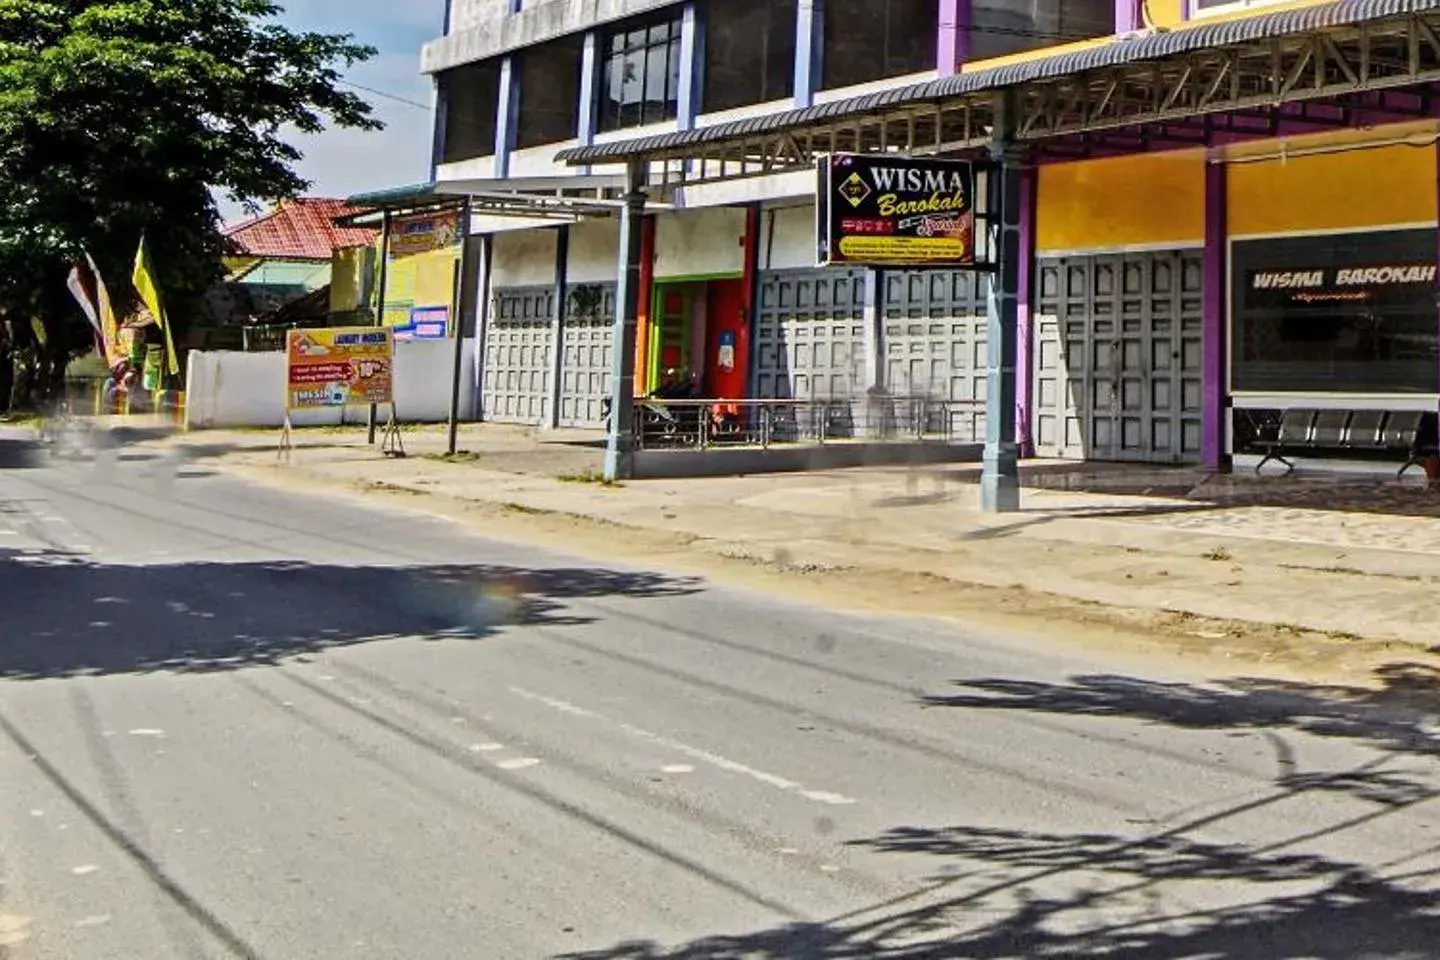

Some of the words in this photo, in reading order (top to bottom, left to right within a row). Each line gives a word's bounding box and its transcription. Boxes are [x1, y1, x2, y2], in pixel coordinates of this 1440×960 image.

[870, 167, 963, 193] WISMA
[877, 191, 964, 216] Barokah
[1253, 270, 1324, 288] WISMA
[1335, 265, 1437, 285] BAROKAH
